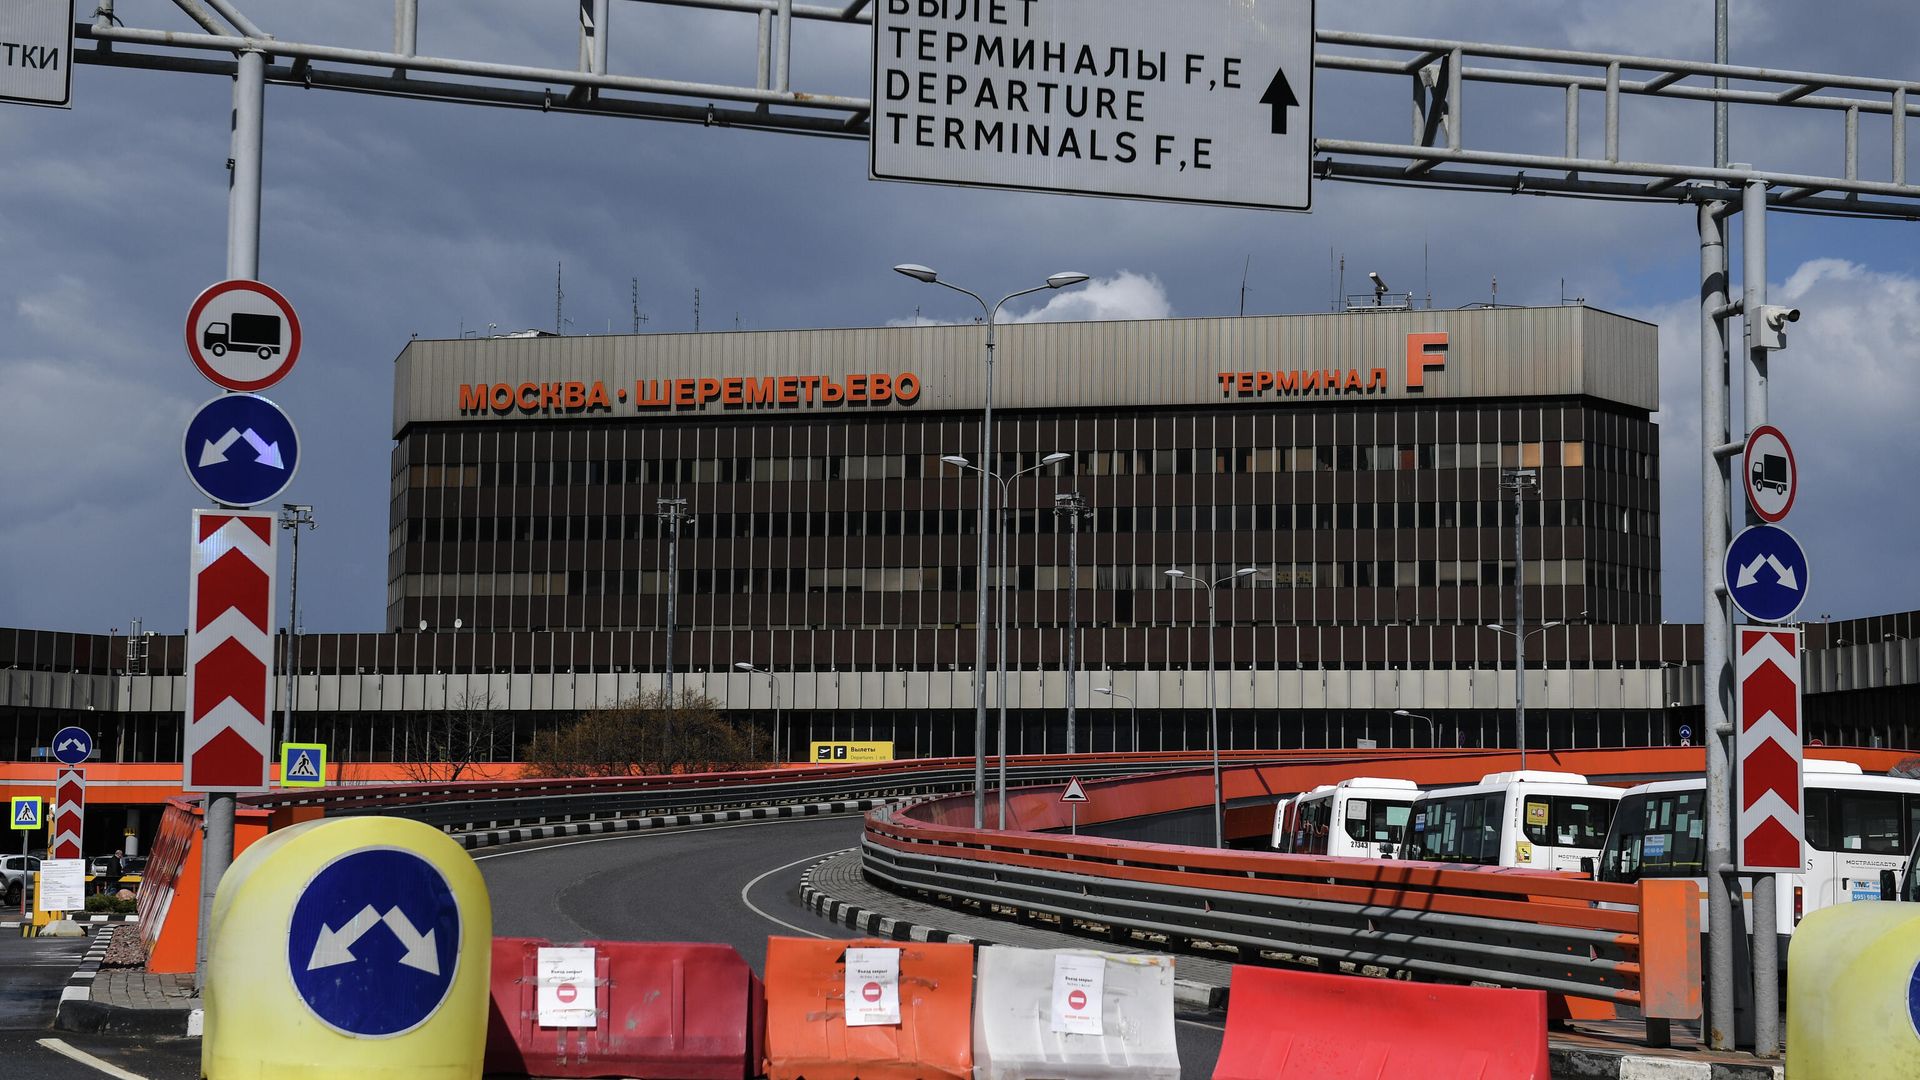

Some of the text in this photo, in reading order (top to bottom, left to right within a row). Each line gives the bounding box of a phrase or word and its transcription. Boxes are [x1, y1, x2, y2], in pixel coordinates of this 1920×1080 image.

[0, 42, 58, 70] ТКИ
[888, 26, 1241, 91] ТЕРМИНАЛЫ F,E
[887, 69, 1145, 121] DEPARTURE
[886, 112, 1212, 171] TERMINALS F,E
[1218, 332, 1448, 394] ТЕРМИНАЛ F
[459, 373, 921, 411] МОСКВА ШЕРЕМЕТЬЕВО
